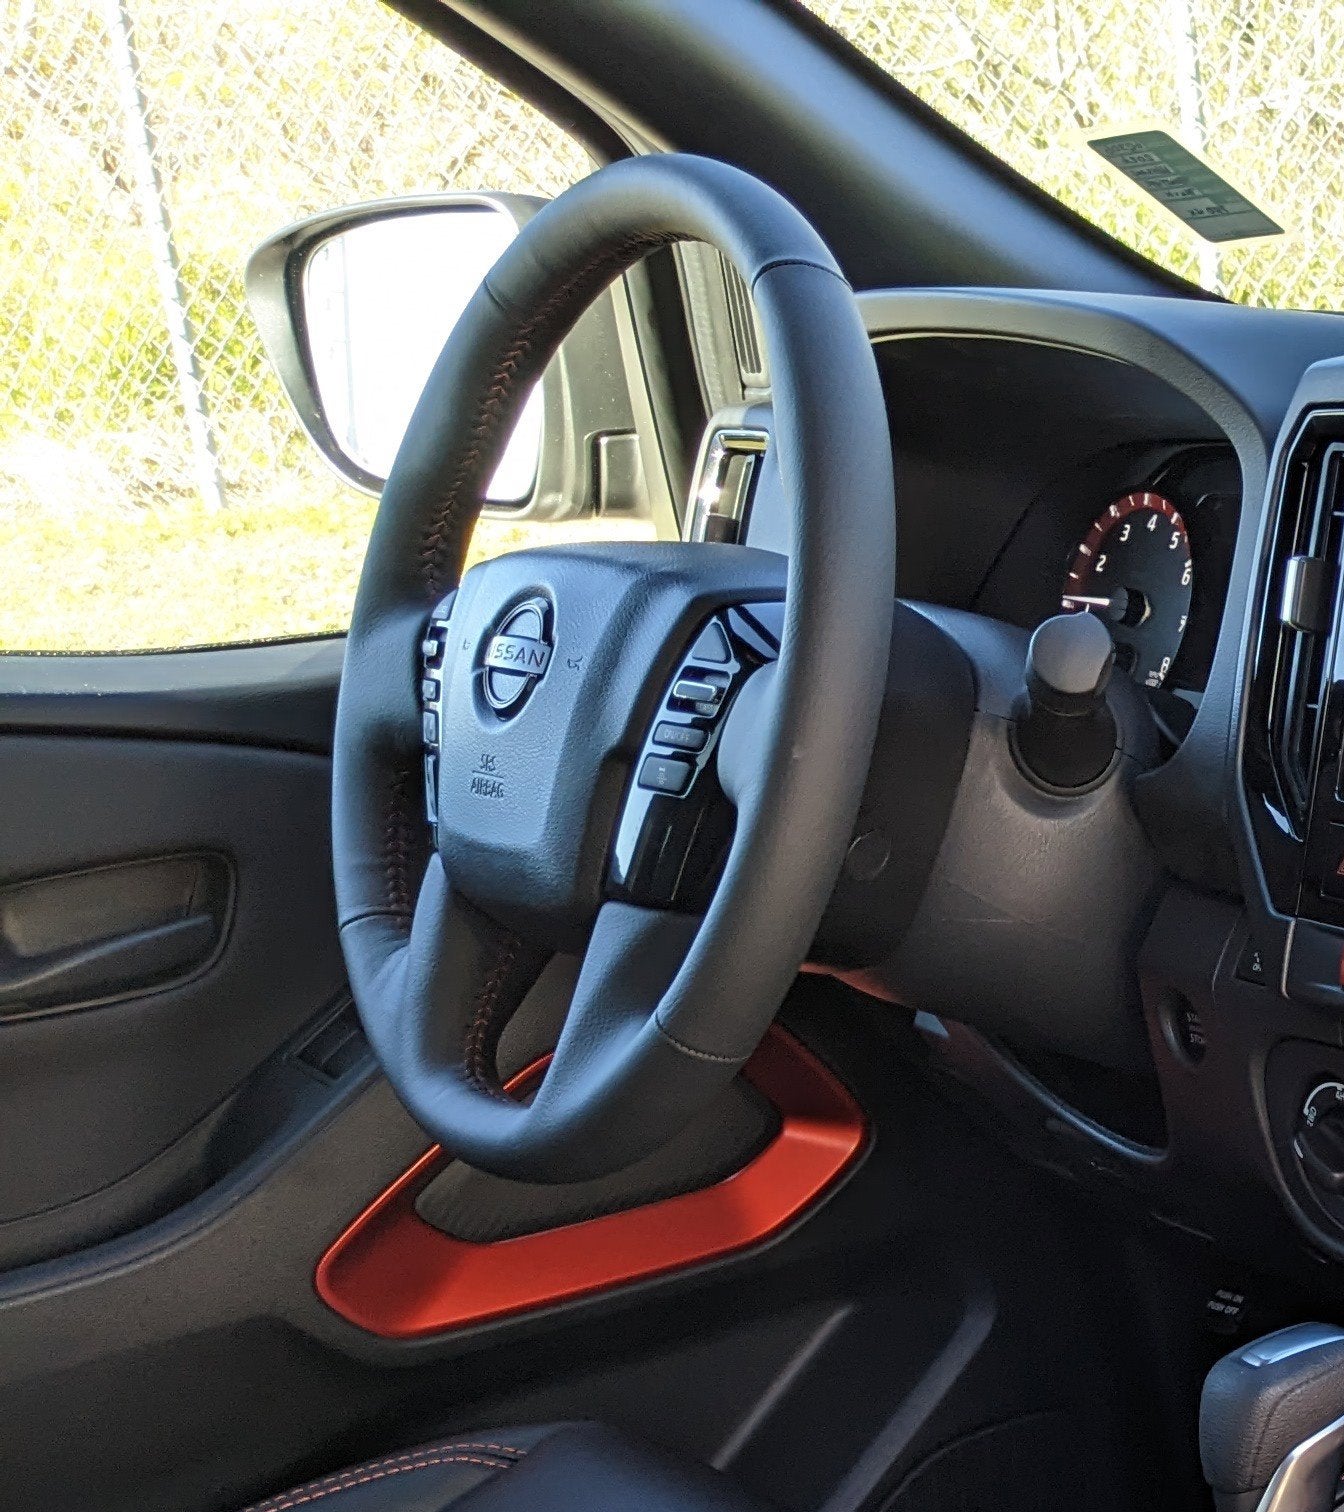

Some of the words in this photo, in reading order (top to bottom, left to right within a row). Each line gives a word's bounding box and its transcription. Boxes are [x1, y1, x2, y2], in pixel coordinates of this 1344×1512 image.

[1147, 514, 1158, 531] 4
[1119, 524, 1131, 542] 3
[1169, 531, 1180, 549] 5
[1095, 554, 1106, 571] 2
[1181, 568, 1191, 585] 6
